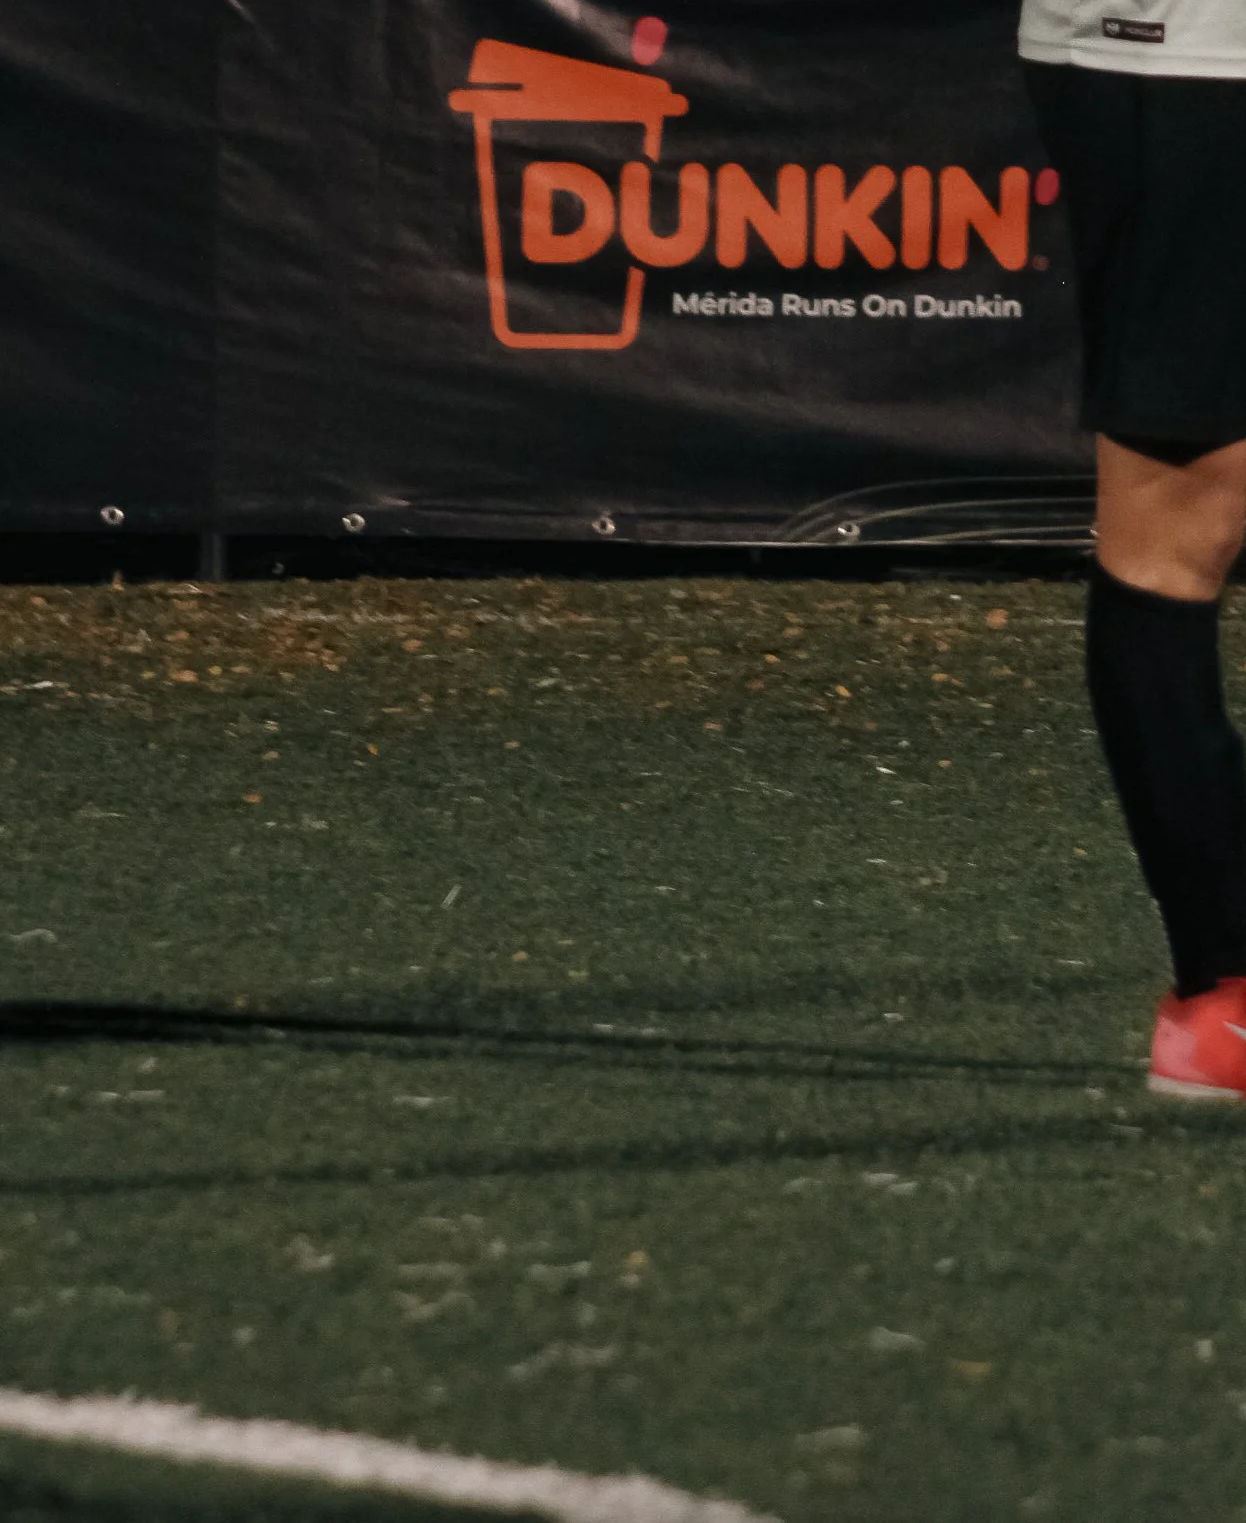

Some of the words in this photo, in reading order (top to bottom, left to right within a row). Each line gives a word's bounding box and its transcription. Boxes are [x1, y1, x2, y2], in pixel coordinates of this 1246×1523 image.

[672, 290, 774, 317] Mérida
[781, 294, 856, 317] Runs
[863, 294, 906, 318] On
[914, 294, 1022, 319] Dunkin
